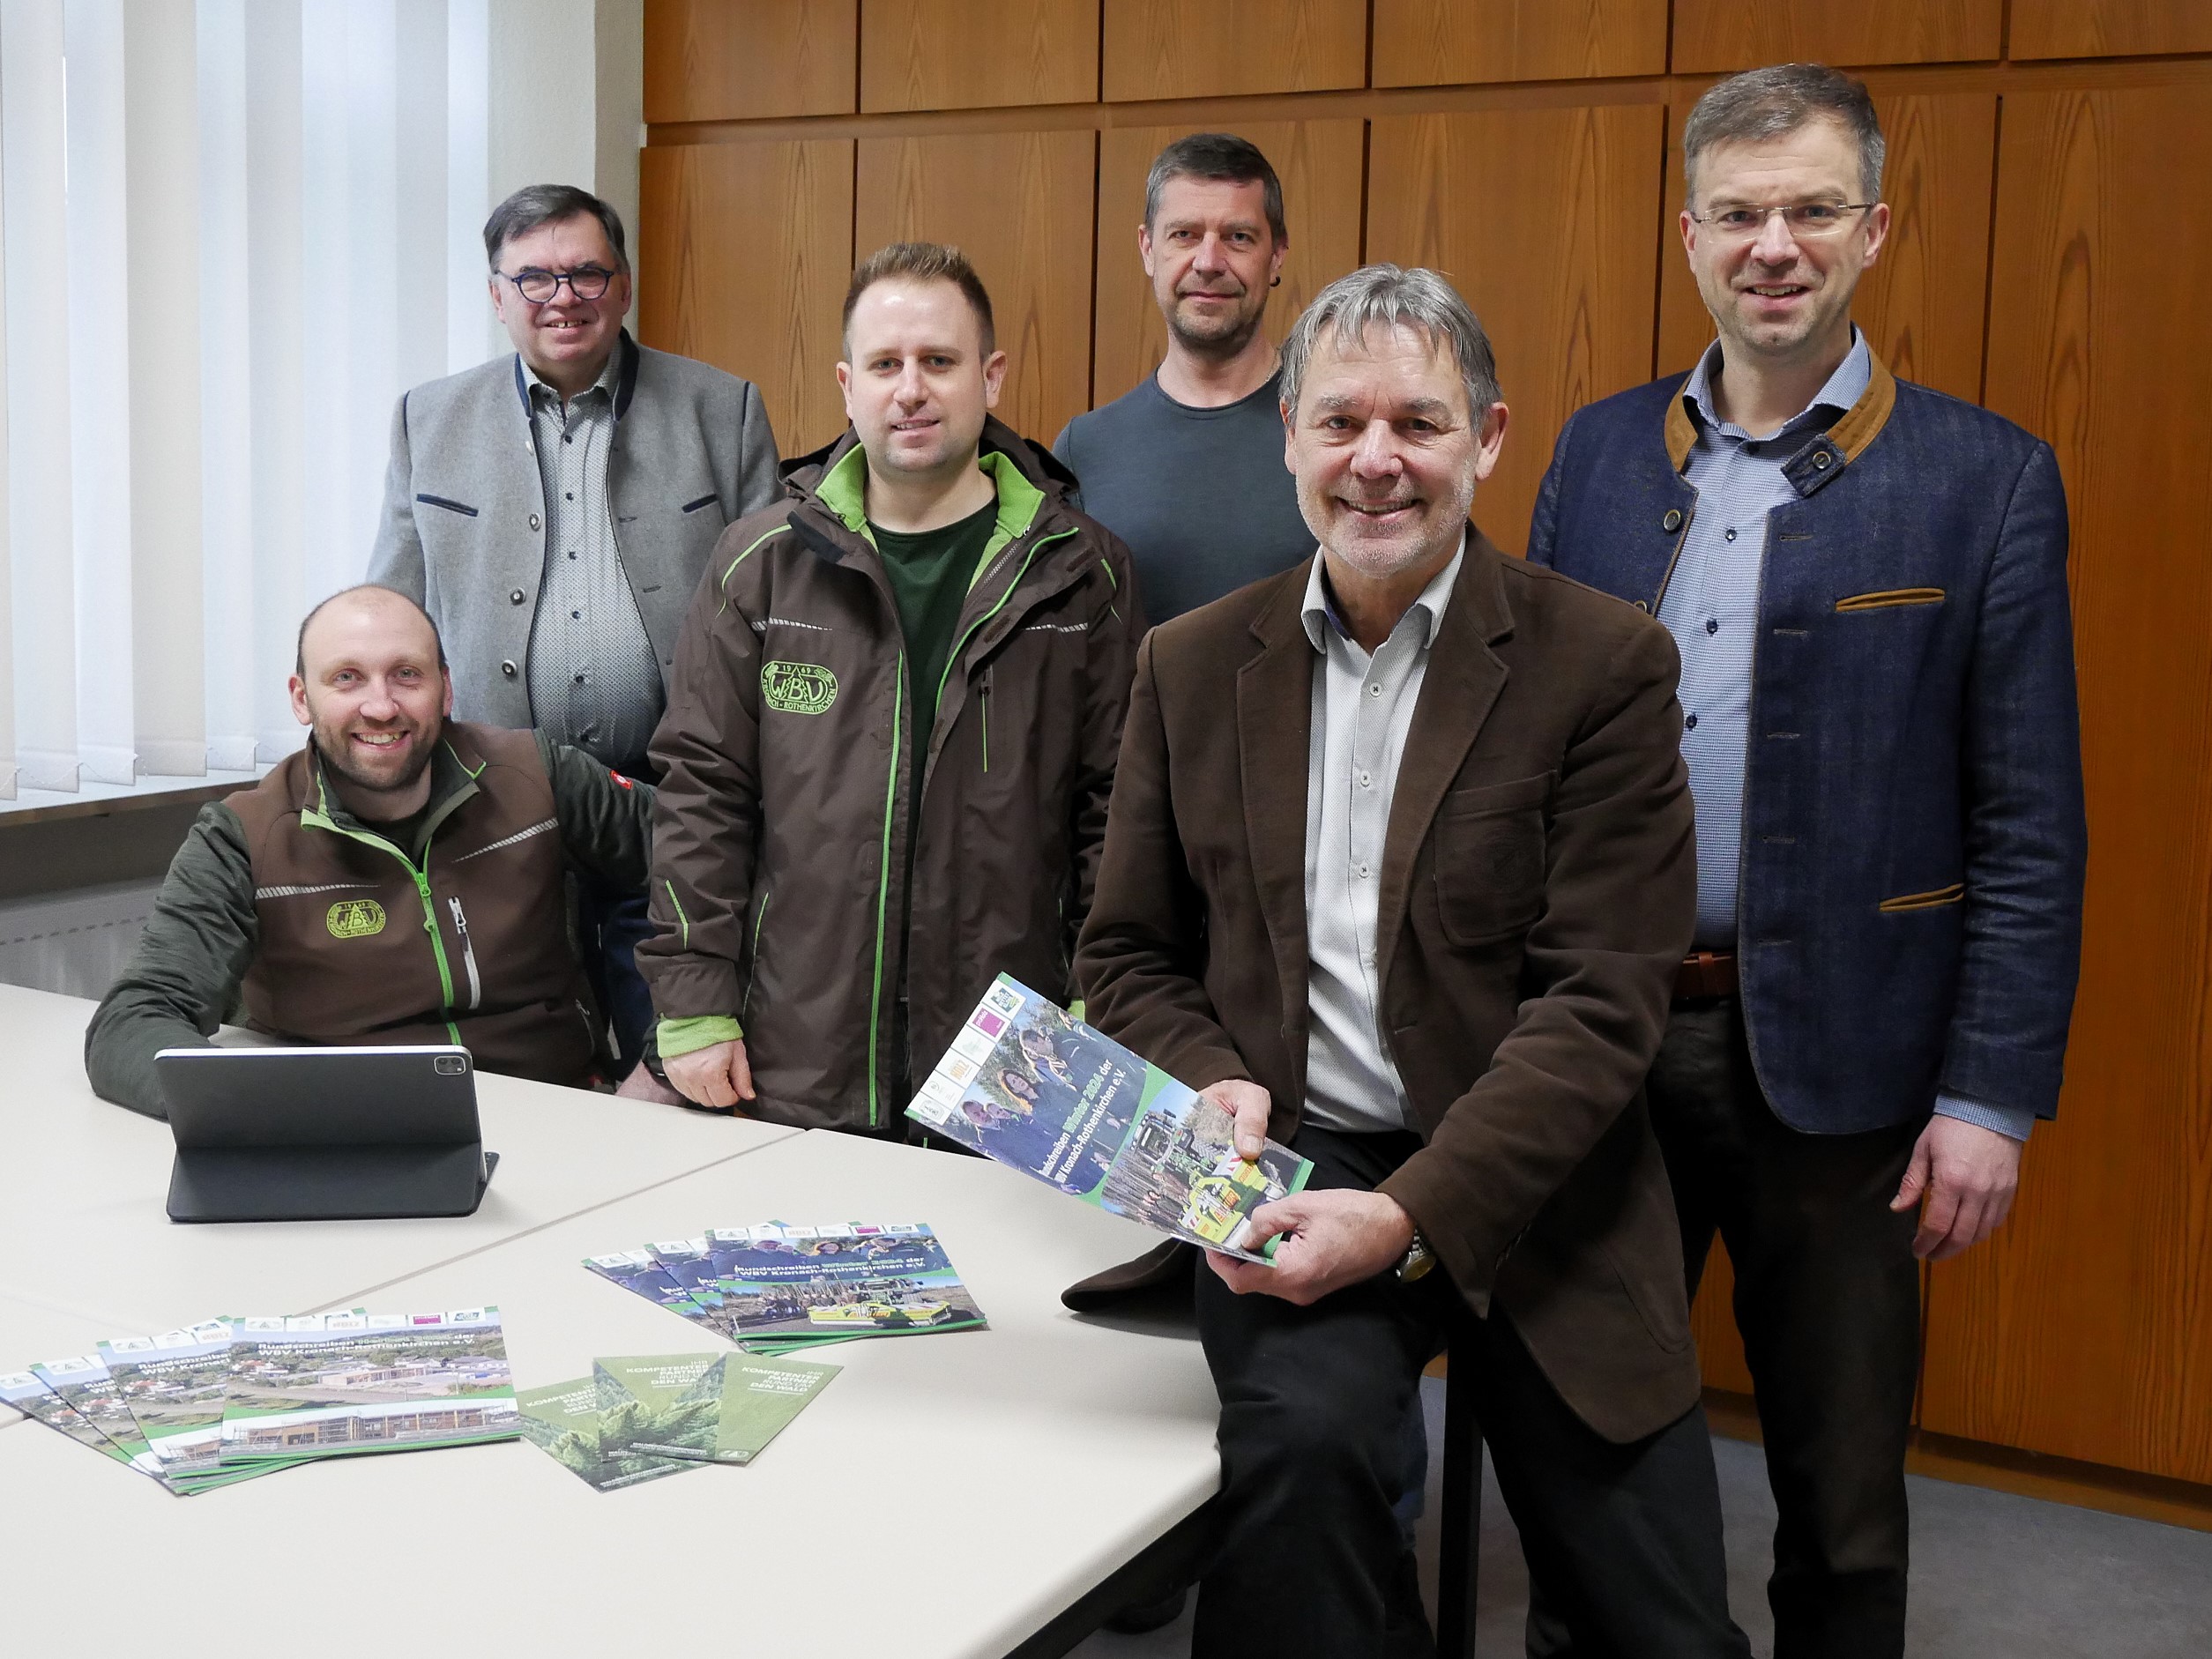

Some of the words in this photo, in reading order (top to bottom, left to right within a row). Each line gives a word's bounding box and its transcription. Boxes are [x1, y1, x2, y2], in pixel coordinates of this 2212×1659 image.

[771, 675, 823, 703] WBV
[1061, 1097, 1090, 1134] Winter
[1083, 1073, 1105, 1100] 2024
[1099, 1059, 1113, 1075] der
[1058, 1085, 1117, 1173] Kronach-Rothenkirchen
[1112, 1068, 1127, 1086] e.V.
[258, 1339, 354, 1350] Rundschreiben
[138, 1353, 230, 1370] Rundschreibe
